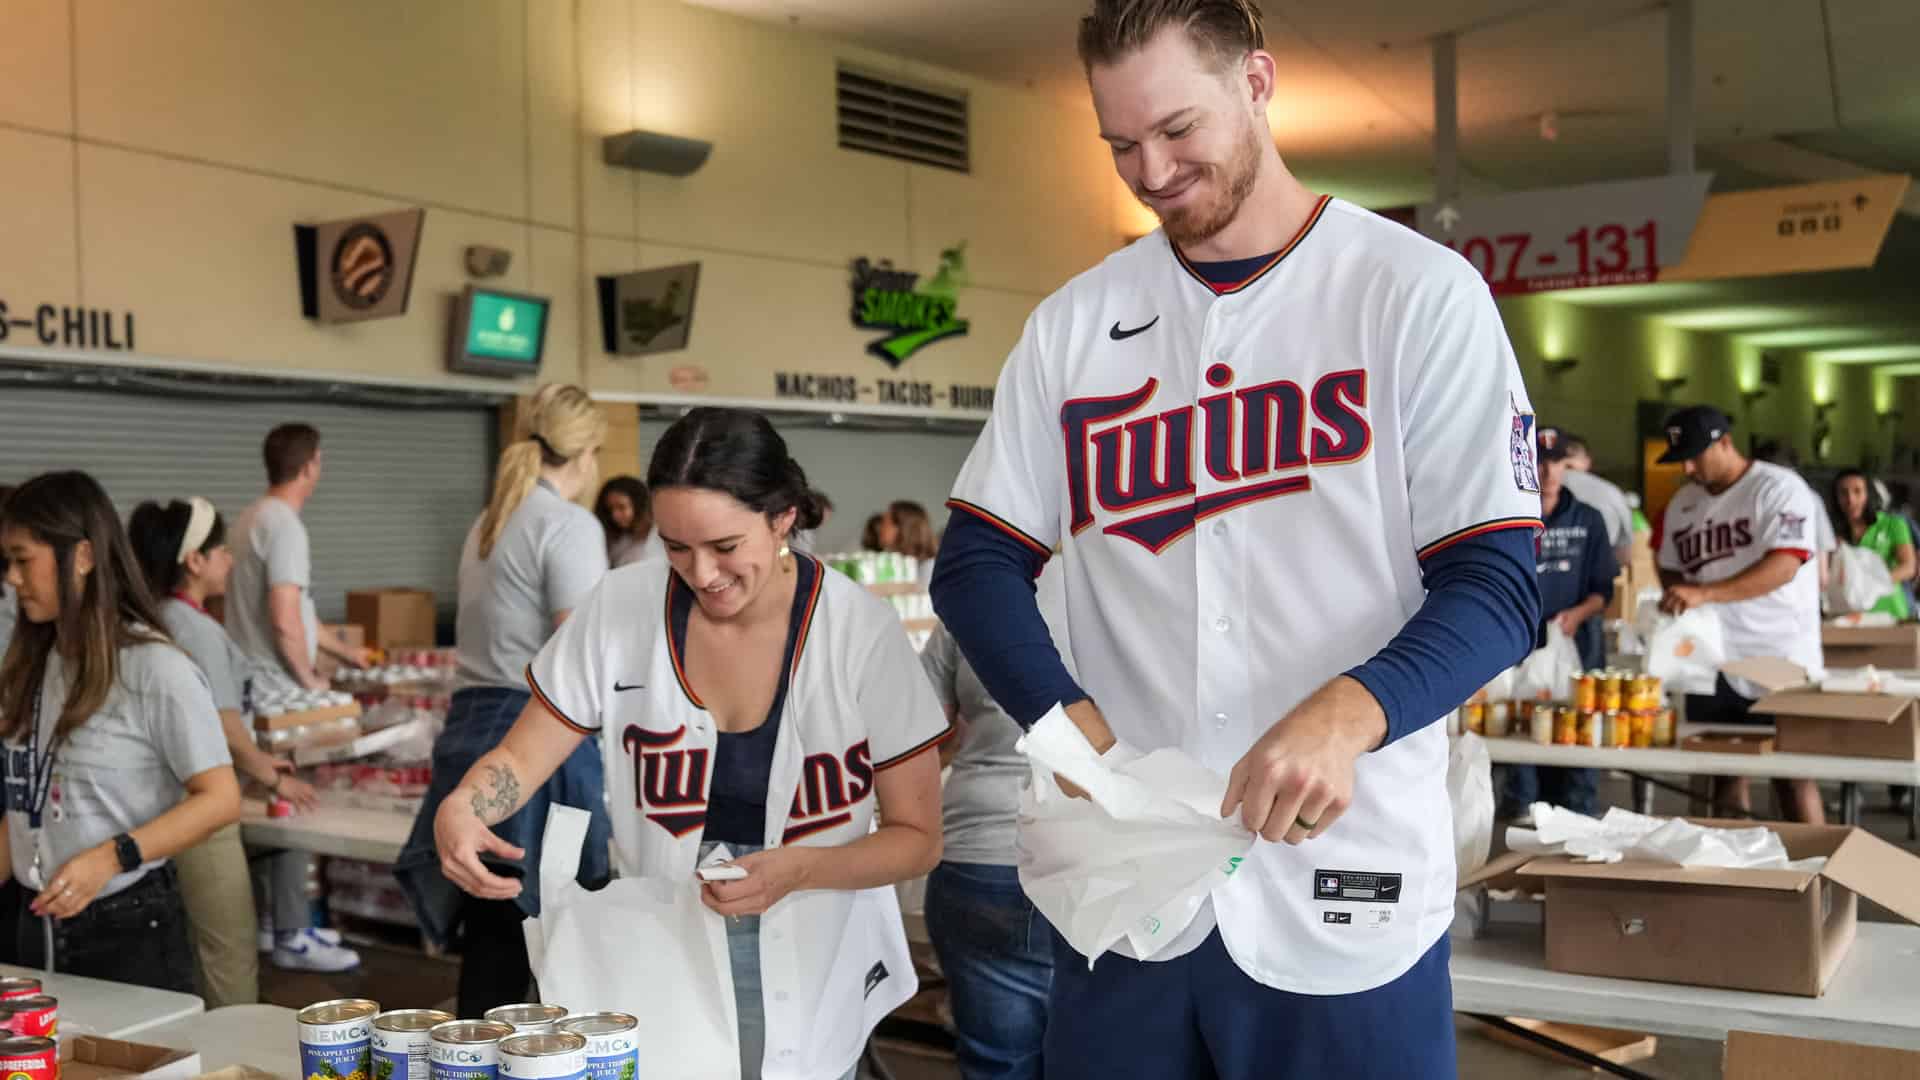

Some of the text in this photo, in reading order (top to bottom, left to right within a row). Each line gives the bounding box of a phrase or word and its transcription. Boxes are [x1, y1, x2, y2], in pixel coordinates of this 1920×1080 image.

[1447, 219, 1657, 284] 07-131
[863, 288, 956, 327] SMOKES
[775, 373, 857, 400] NACHOS
[877, 379, 932, 407] TACOS
[1061, 363, 1374, 537] Twins
[1672, 519, 1753, 569] Twins
